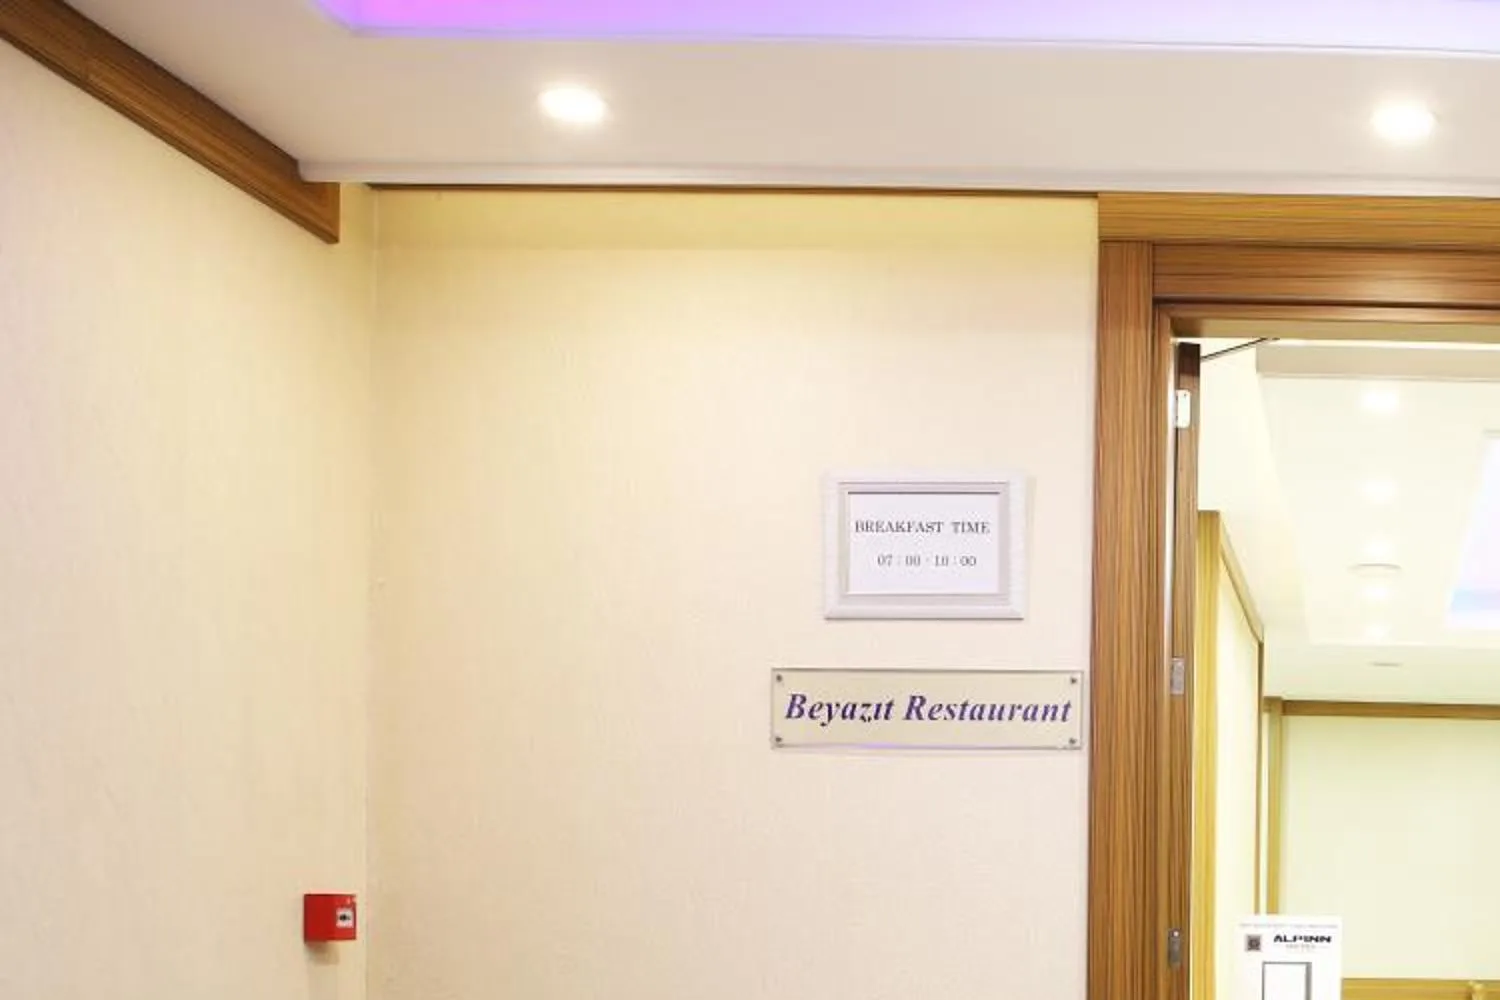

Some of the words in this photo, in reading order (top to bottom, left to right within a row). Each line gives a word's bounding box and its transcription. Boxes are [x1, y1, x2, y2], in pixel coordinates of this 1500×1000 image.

[855, 519, 945, 534] BREAKFAST
[951, 520, 991, 535] TIME
[785, 693, 895, 727] Beyazıt
[905, 695, 1072, 723] Restaurant
[1273, 934, 1333, 944] ALPINN
